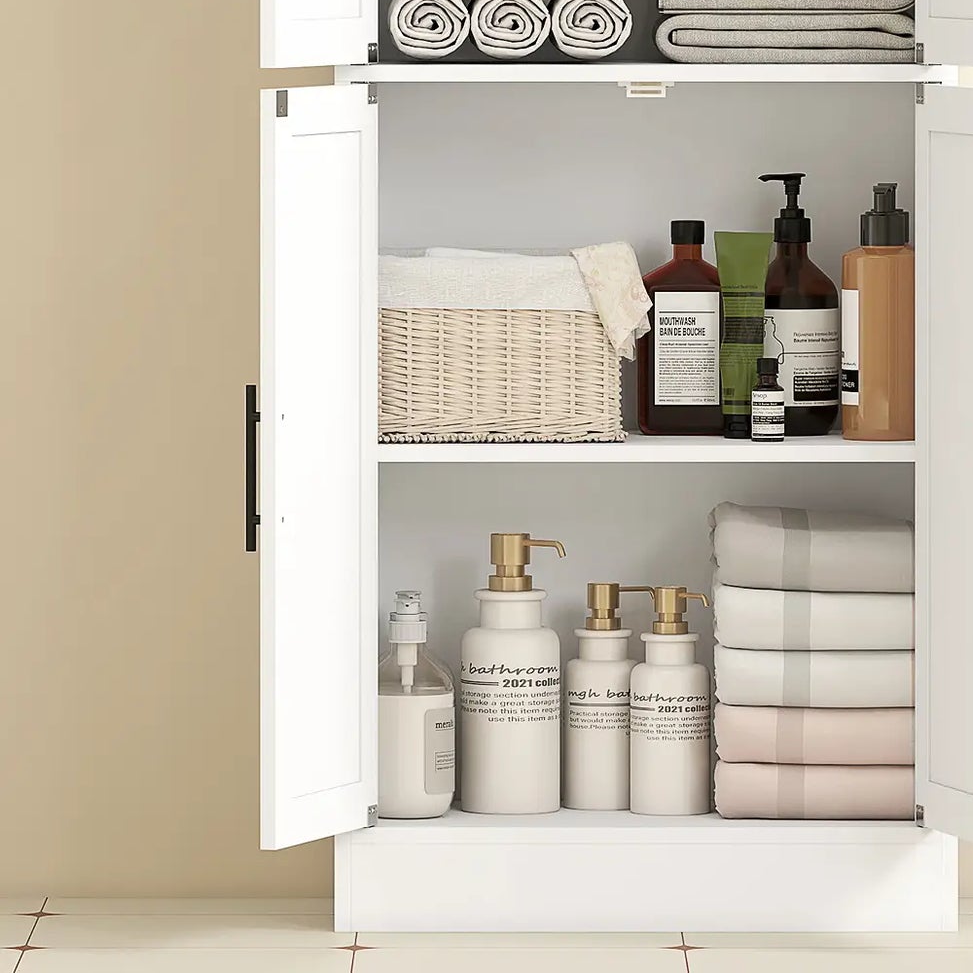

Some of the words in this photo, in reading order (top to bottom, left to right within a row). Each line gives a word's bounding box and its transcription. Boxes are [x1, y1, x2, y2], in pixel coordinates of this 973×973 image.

[659, 317, 696, 326] MOUTHWASH
[660, 327, 673, 336] BAIN
[674, 327, 682, 336] DE
[682, 327, 706, 336] BOUCHE
[469, 662, 559, 676] bathroom
[502, 678, 533, 688] 2021
[633, 692, 707, 703] bathroom
[658, 705, 682, 713] 2021
